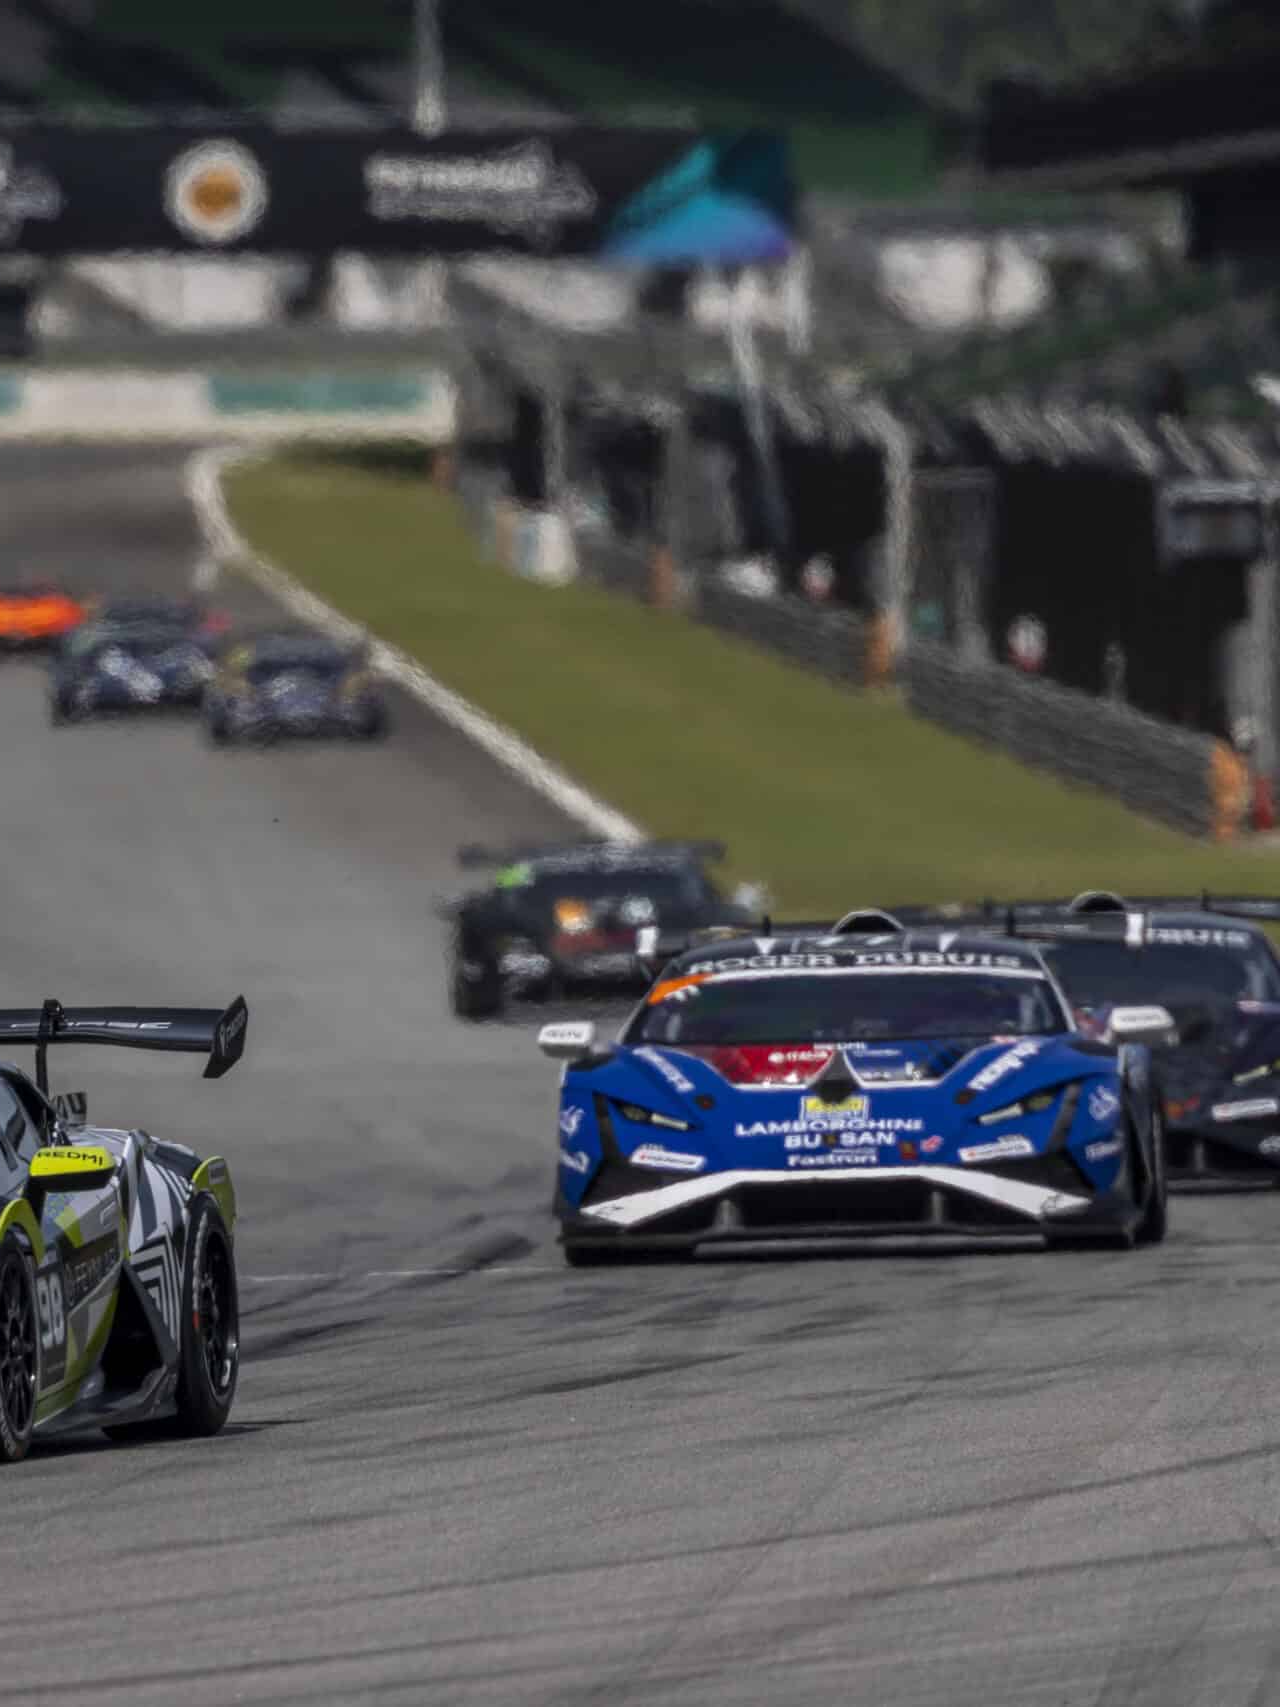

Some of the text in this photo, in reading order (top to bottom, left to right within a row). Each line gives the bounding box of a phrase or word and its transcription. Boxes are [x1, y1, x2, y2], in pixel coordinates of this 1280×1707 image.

[686, 950, 1021, 976] ROGER DUBUIS
[734, 1118, 925, 1136] LAMBORGHINI
[36, 1150, 104, 1168] REDMI
[35, 1272, 66, 1349] 98
